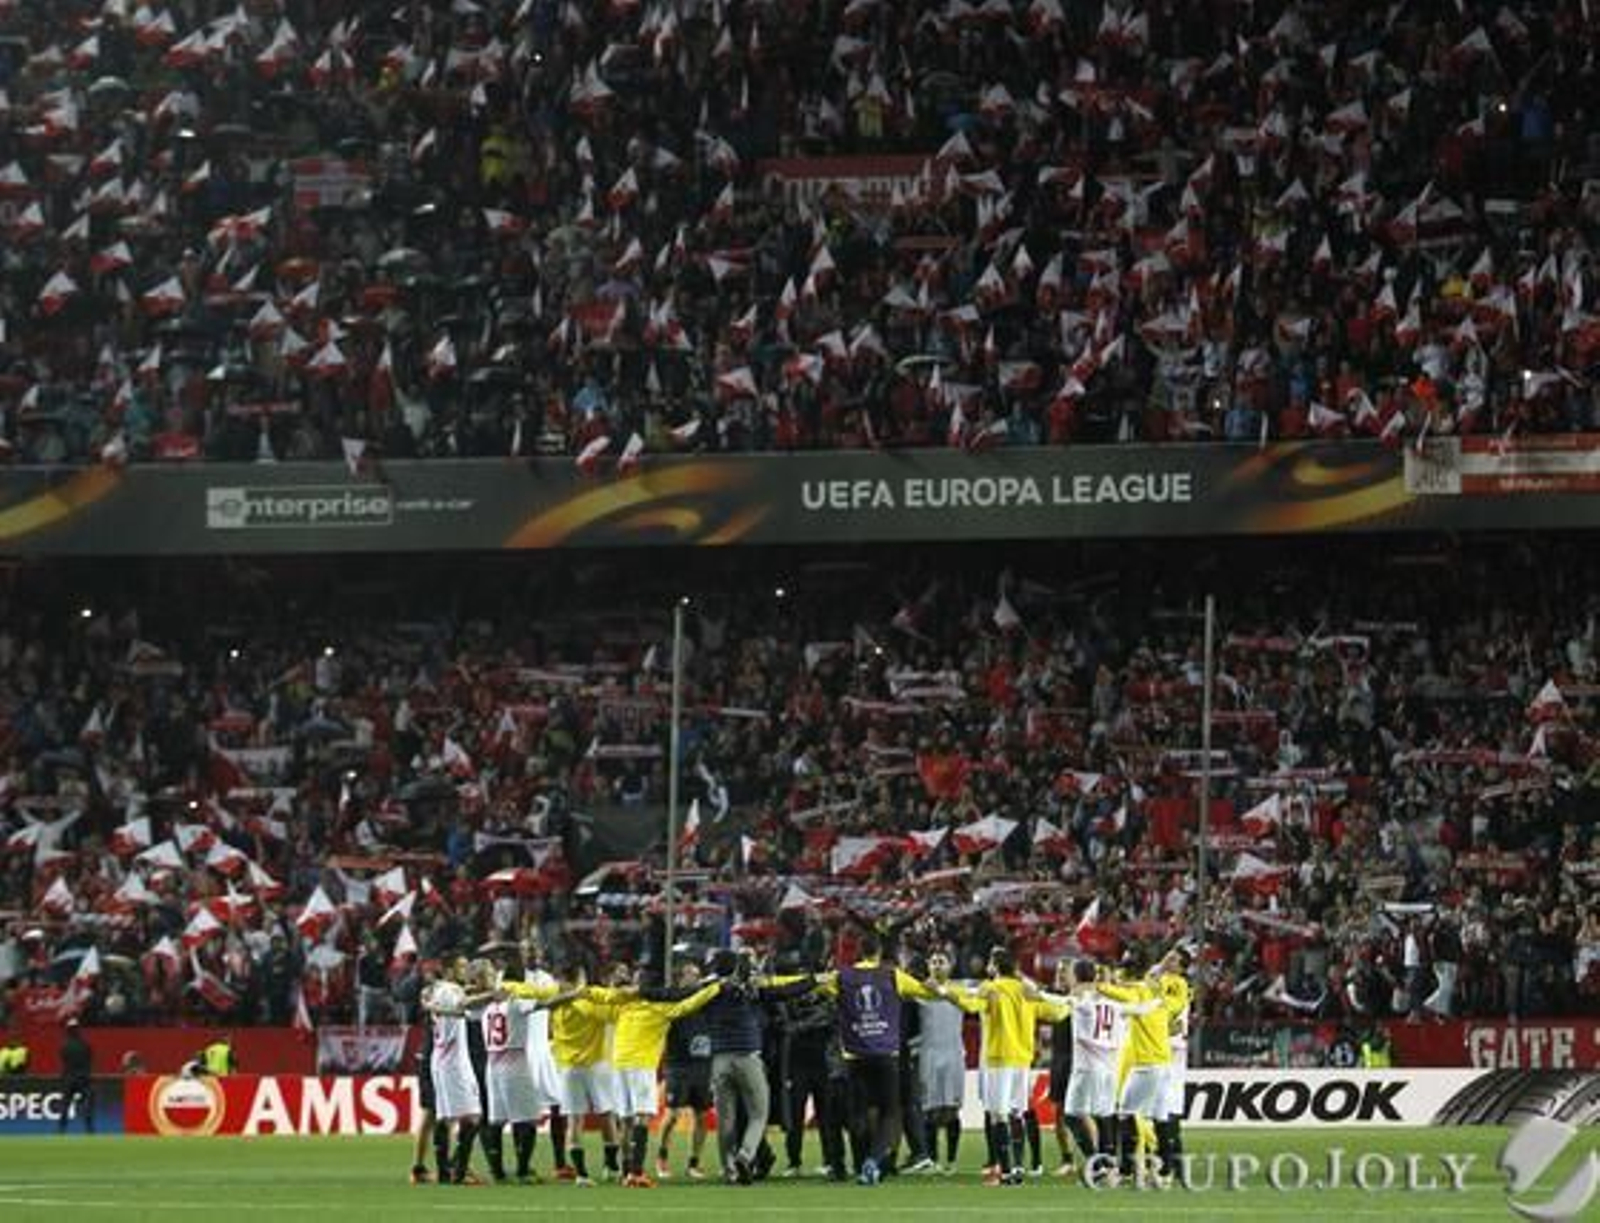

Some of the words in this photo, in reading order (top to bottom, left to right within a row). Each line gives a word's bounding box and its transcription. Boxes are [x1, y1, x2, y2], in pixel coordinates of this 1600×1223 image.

[222, 491, 389, 520] enterprise
[802, 478, 894, 509] UEFA
[905, 475, 1041, 508] EUROPA
[1052, 472, 1192, 504] LEAGUE
[487, 1012, 508, 1046] 19
[1093, 1004, 1114, 1039] 14
[1470, 1028, 1574, 1067] GATE
